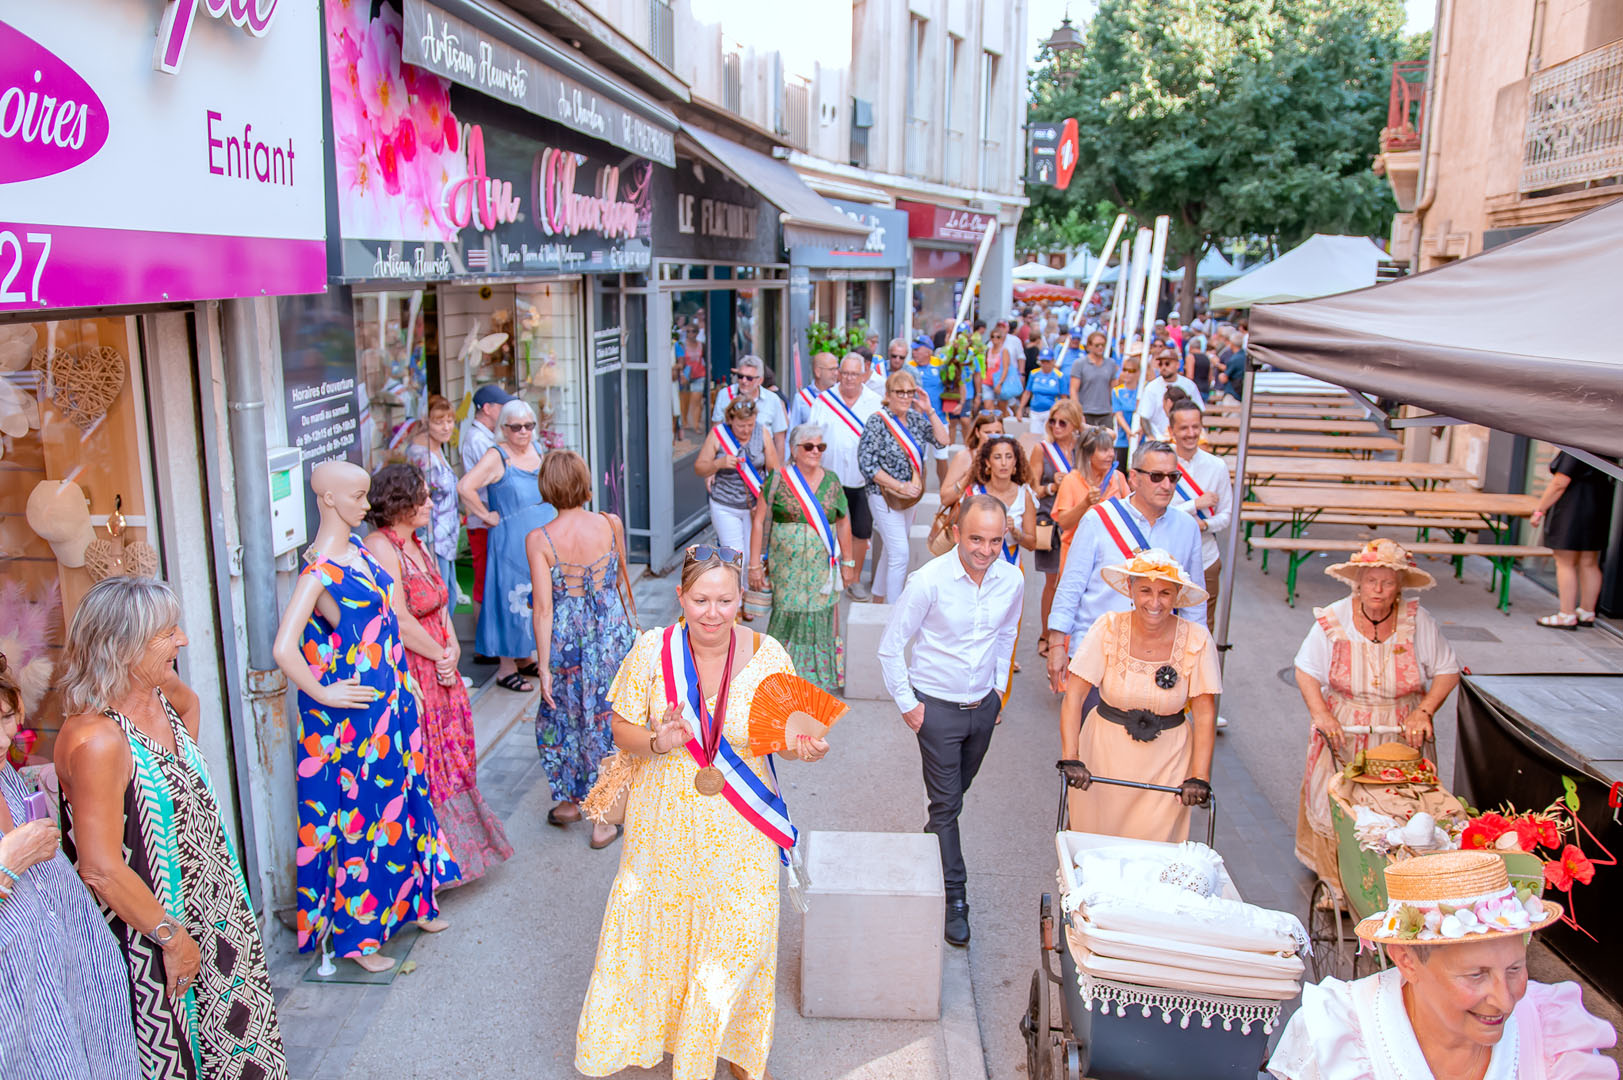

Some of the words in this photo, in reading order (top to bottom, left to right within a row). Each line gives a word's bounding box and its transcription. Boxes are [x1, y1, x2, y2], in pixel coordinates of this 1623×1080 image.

[421, 12, 477, 80] Artisan
[479, 40, 529, 98] Fleuriste
[206, 109, 295, 186] Enfant
[440, 122, 521, 233] Au
[538, 146, 640, 238] Chardon
[678, 192, 696, 233] LE
[0, 230, 52, 303] 27
[372, 246, 411, 278] Artisan
[413, 247, 451, 277] Fleuriste
[292, 386, 320, 402] Horaires
[320, 379, 354, 395] d'ouverture
[301, 415, 310, 427] Du
[310, 410, 325, 424] mardi
[325, 411, 332, 420] au
[332, 403, 349, 417] samedi
[295, 435, 304, 447] de
[327, 426, 333, 437] et
[326, 440, 333, 452] de
